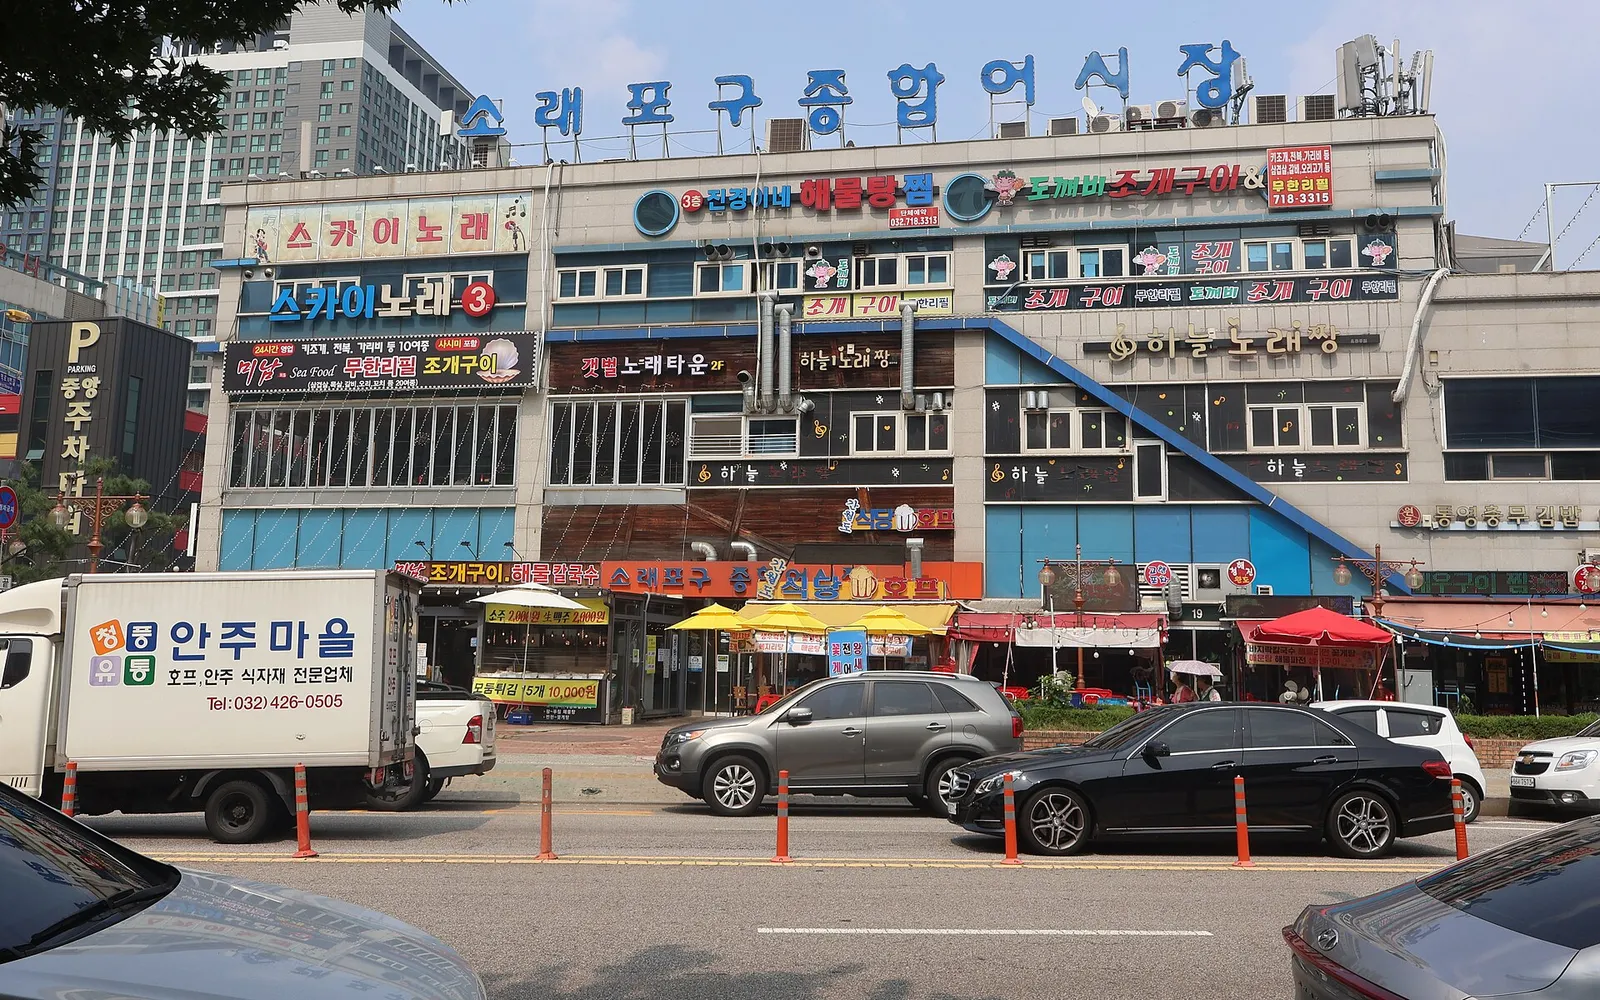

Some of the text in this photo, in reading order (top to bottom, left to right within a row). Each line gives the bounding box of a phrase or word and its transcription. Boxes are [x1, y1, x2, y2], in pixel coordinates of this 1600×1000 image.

[1272, 178, 1329, 192] 무한리필
[682, 194, 701, 208] 3층
[707, 185, 791, 212] 진경이네
[1273, 192, 1329, 204] 718-3315
[286, 213, 489, 249] 스카이노래
[890, 217, 938, 227] 032.718.3313
[1192, 241, 1233, 260] 조개
[837, 258, 849, 288] 도깨비
[1025, 289, 1069, 309] 조개
[1080, 286, 1123, 307] 구이
[1135, 288, 1181, 302] 무한리필
[1189, 286, 1239, 301] 도깨비
[1247, 280, 1294, 302] 조개
[1306, 278, 1353, 301] 구이
[1362, 279, 1396, 294] 무한리필
[806, 296, 949, 316] 조개 구이 한리필
[67, 322, 101, 364] P
[254, 345, 278, 354] 24시간
[280, 345, 293, 354] 영업
[357, 341, 383, 353] 가리비
[387, 341, 396, 353] 등
[399, 340, 430, 352] 10여종
[438, 339, 462, 348] 사시미
[463, 339, 478, 348] 포함
[67, 364, 96, 373] PARKING
[290, 366, 307, 378] Sea
[309, 364, 336, 377] Food
[343, 355, 417, 378] 무한리필
[423, 353, 498, 375] 조개구이
[581, 356, 617, 378] 갯벌
[710, 360, 724, 371] 2F
[61, 376, 101, 399] 중앙
[855, 508, 955, 530] 식당 호프
[1402, 505, 1418, 525] 원조
[608, 566, 711, 588] 소래포구
[883, 576, 940, 600] 호프
[488, 609, 506, 622] 소주
[571, 610, 606, 623] 2,000원
[1191, 608, 1203, 619] 19
[169, 616, 356, 661] 안주마을
[167, 664, 354, 687] 호프,안주 식자재 전문업체
[548, 685, 596, 699] 10,000원
